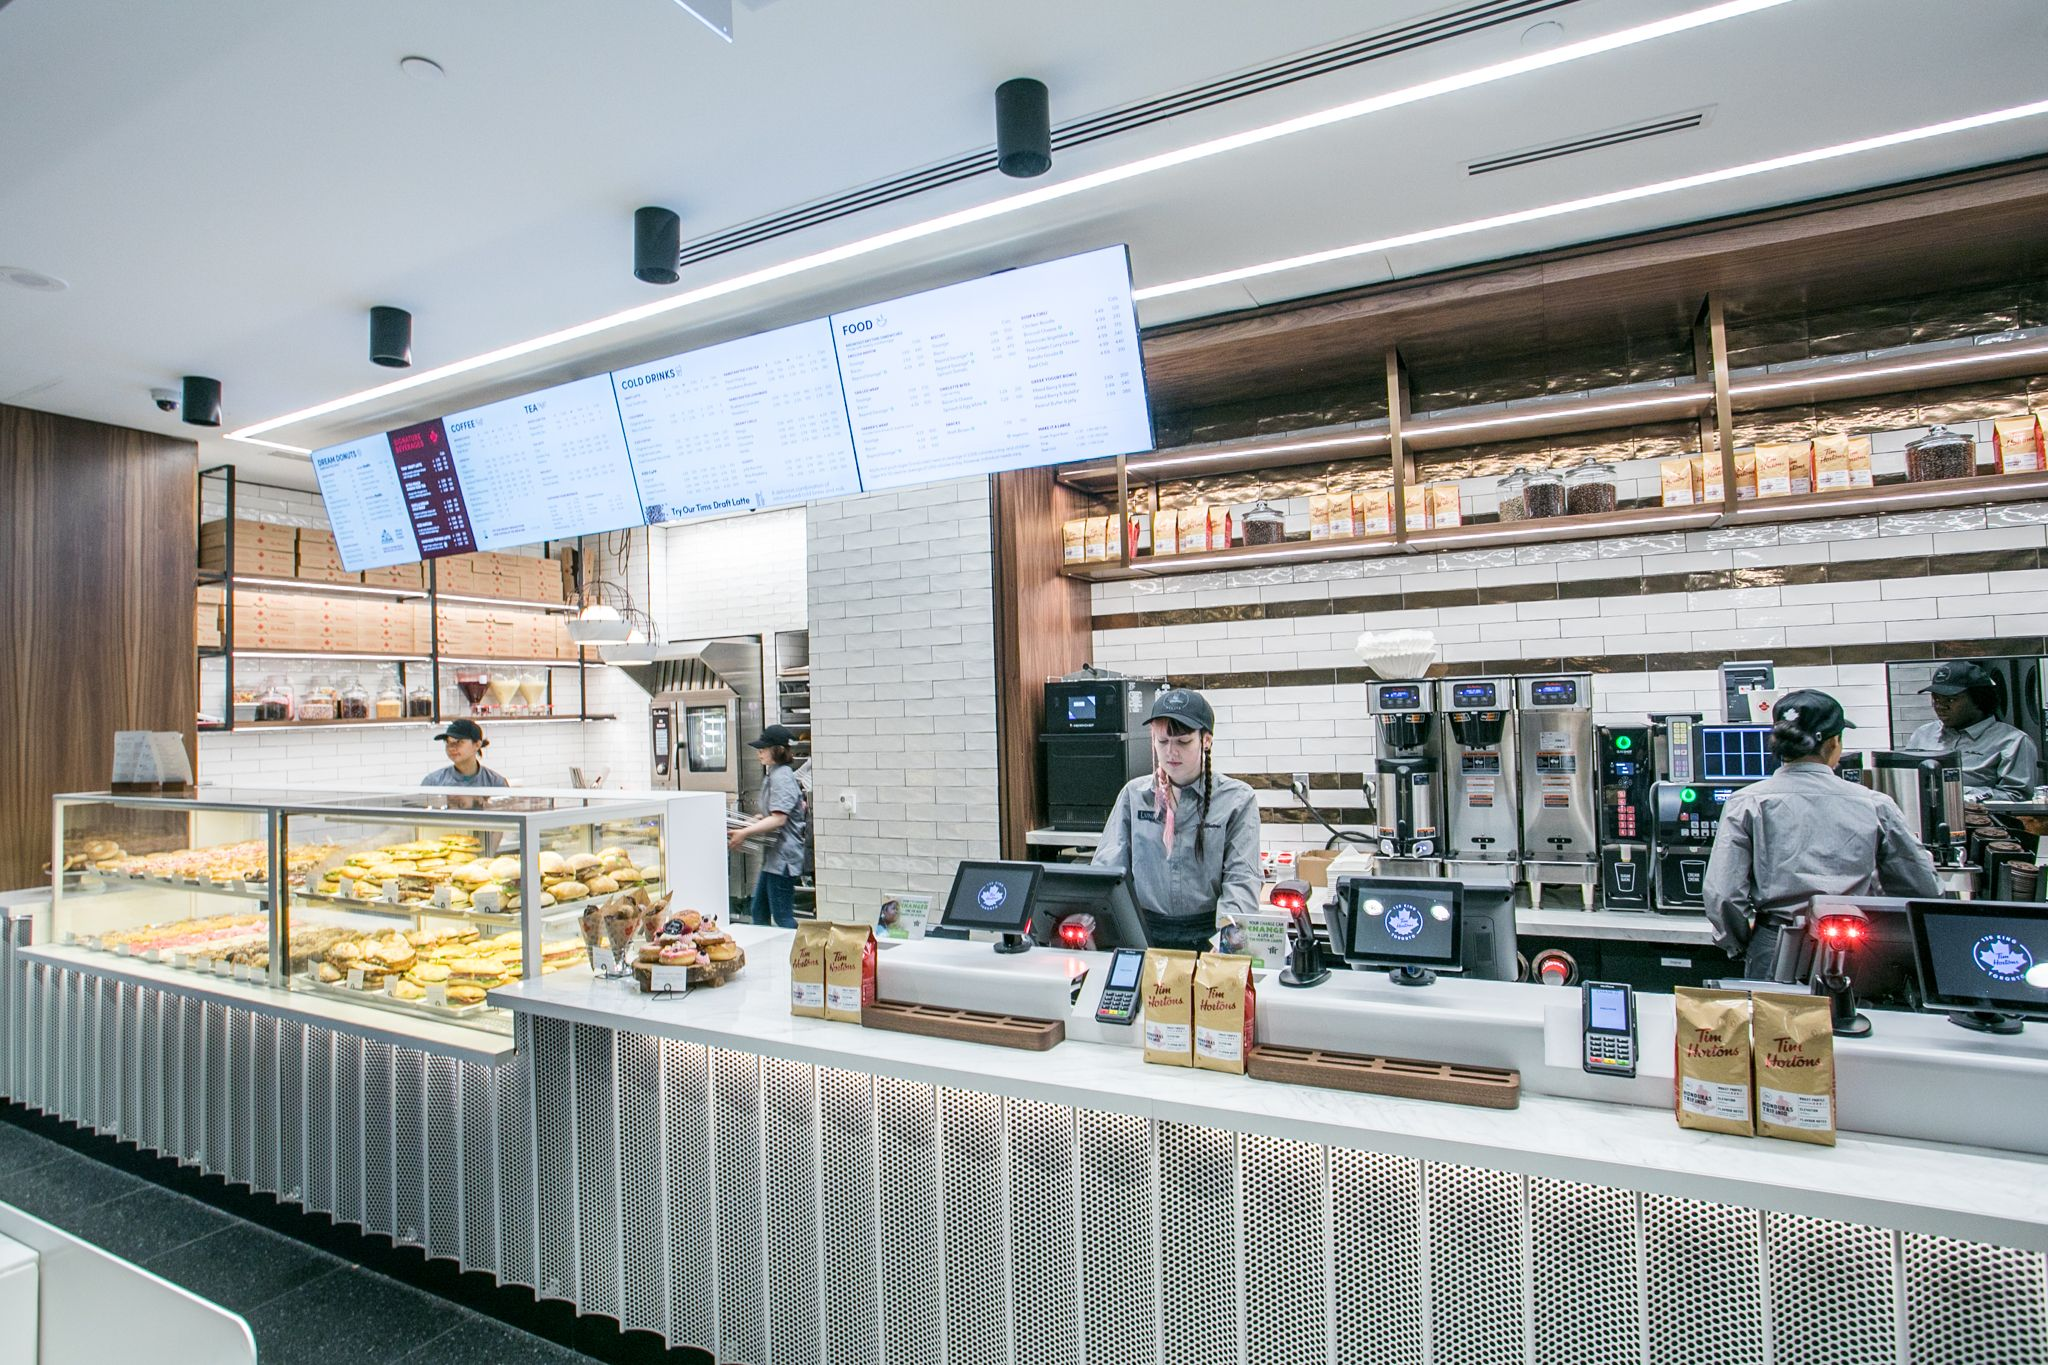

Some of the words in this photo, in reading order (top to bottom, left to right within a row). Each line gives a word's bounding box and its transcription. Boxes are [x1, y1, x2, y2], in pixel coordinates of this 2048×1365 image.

[842, 318, 874, 336] FOOD
[621, 378, 644, 390] COLD
[645, 369, 676, 384] DRINKS
[524, 403, 538, 414] TEA
[451, 419, 475, 433] COFFEE
[317, 455, 335, 466] DREAM
[336, 450, 357, 462] DONUTS
[671, 507, 682, 517] Try
[683, 504, 695, 514] Our
[695, 502, 713, 512] Tims
[713, 498, 732, 508] Draft
[732, 496, 750, 505] Latte
[833, 951, 847, 962] Tim
[829, 962, 856, 972] Hortons
[1988, 971, 2025, 981] TORONTO
[1153, 983, 1171, 996] Tim
[1206, 986, 1225, 999] Tim
[1148, 995, 1184, 1008] Hortons
[1199, 999, 1237, 1012] Hortons
[1695, 1027, 1723, 1044] Tim
[1687, 1043, 1740, 1058] Hortons
[1773, 1037, 1803, 1053] Tim
[1765, 1053, 1821, 1068] Hortons
[1683, 1090, 1713, 1102] HONDURAS
[1762, 1101, 1794, 1113] HONDURAS
